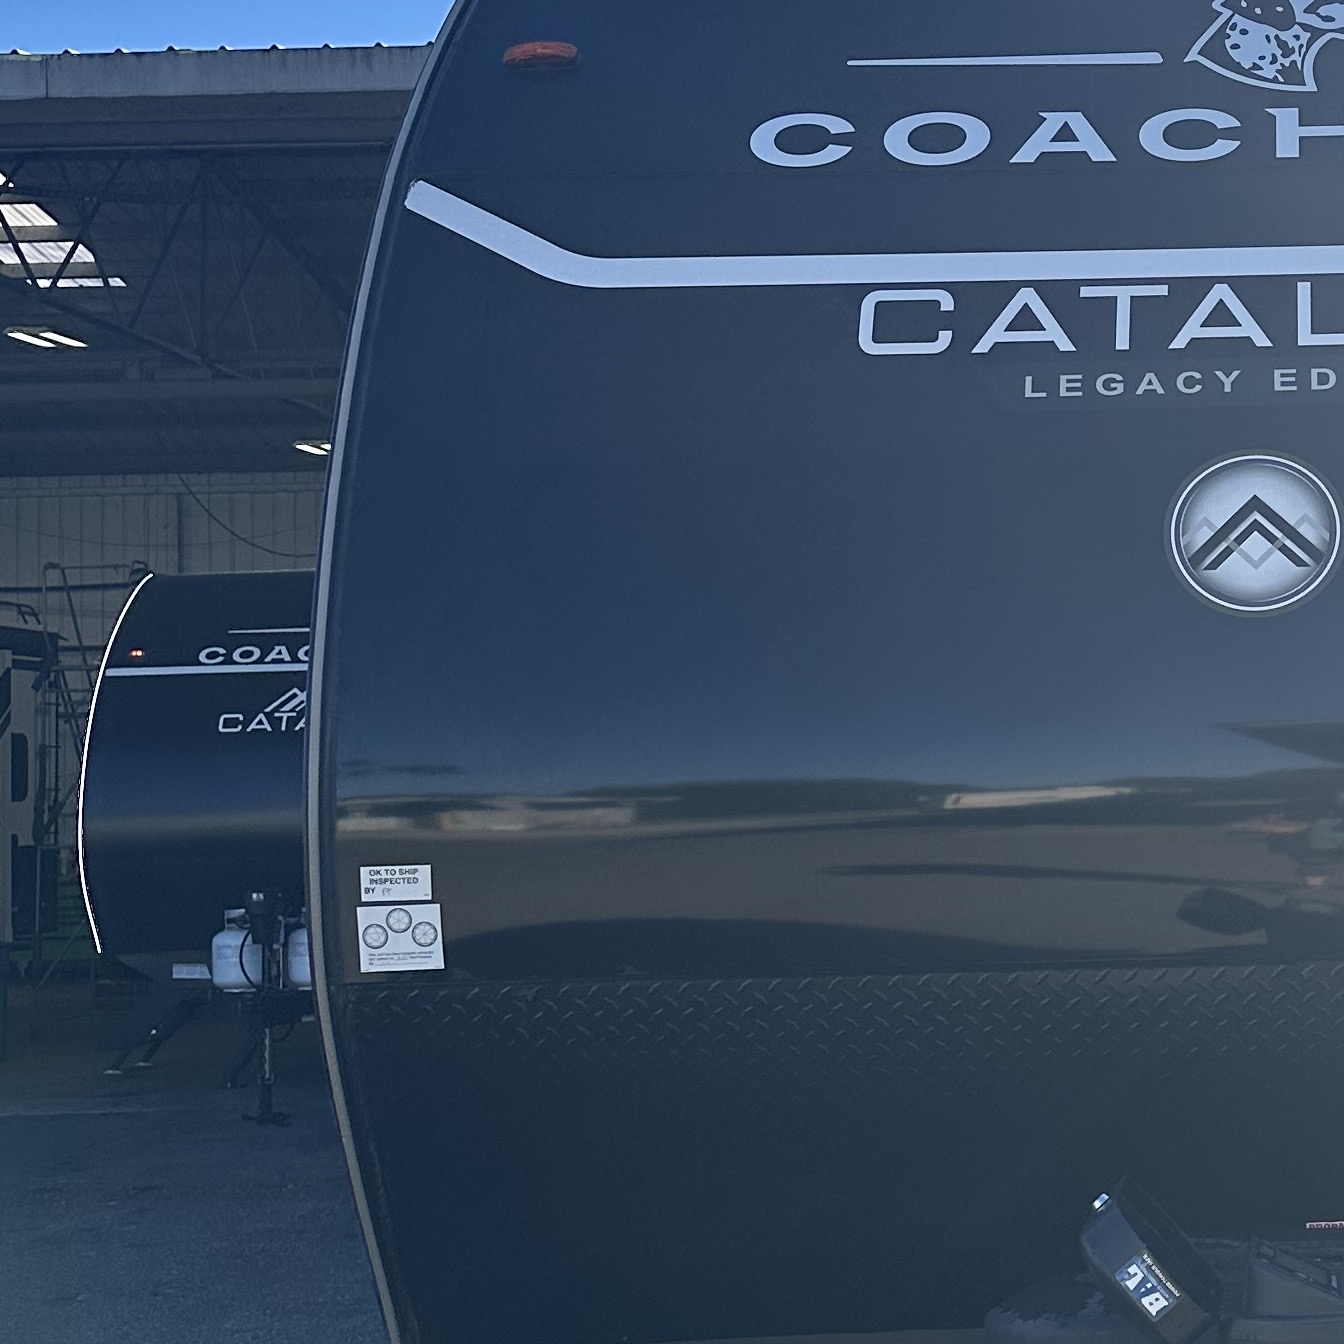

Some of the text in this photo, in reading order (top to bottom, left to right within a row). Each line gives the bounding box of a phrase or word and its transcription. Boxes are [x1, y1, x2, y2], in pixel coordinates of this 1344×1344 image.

[1022, 370, 1243, 399] LEGACY
[368, 867, 419, 877] OK TO SHIP
[369, 876, 419, 885] INSPECTED
[364, 886, 376, 895] BY
